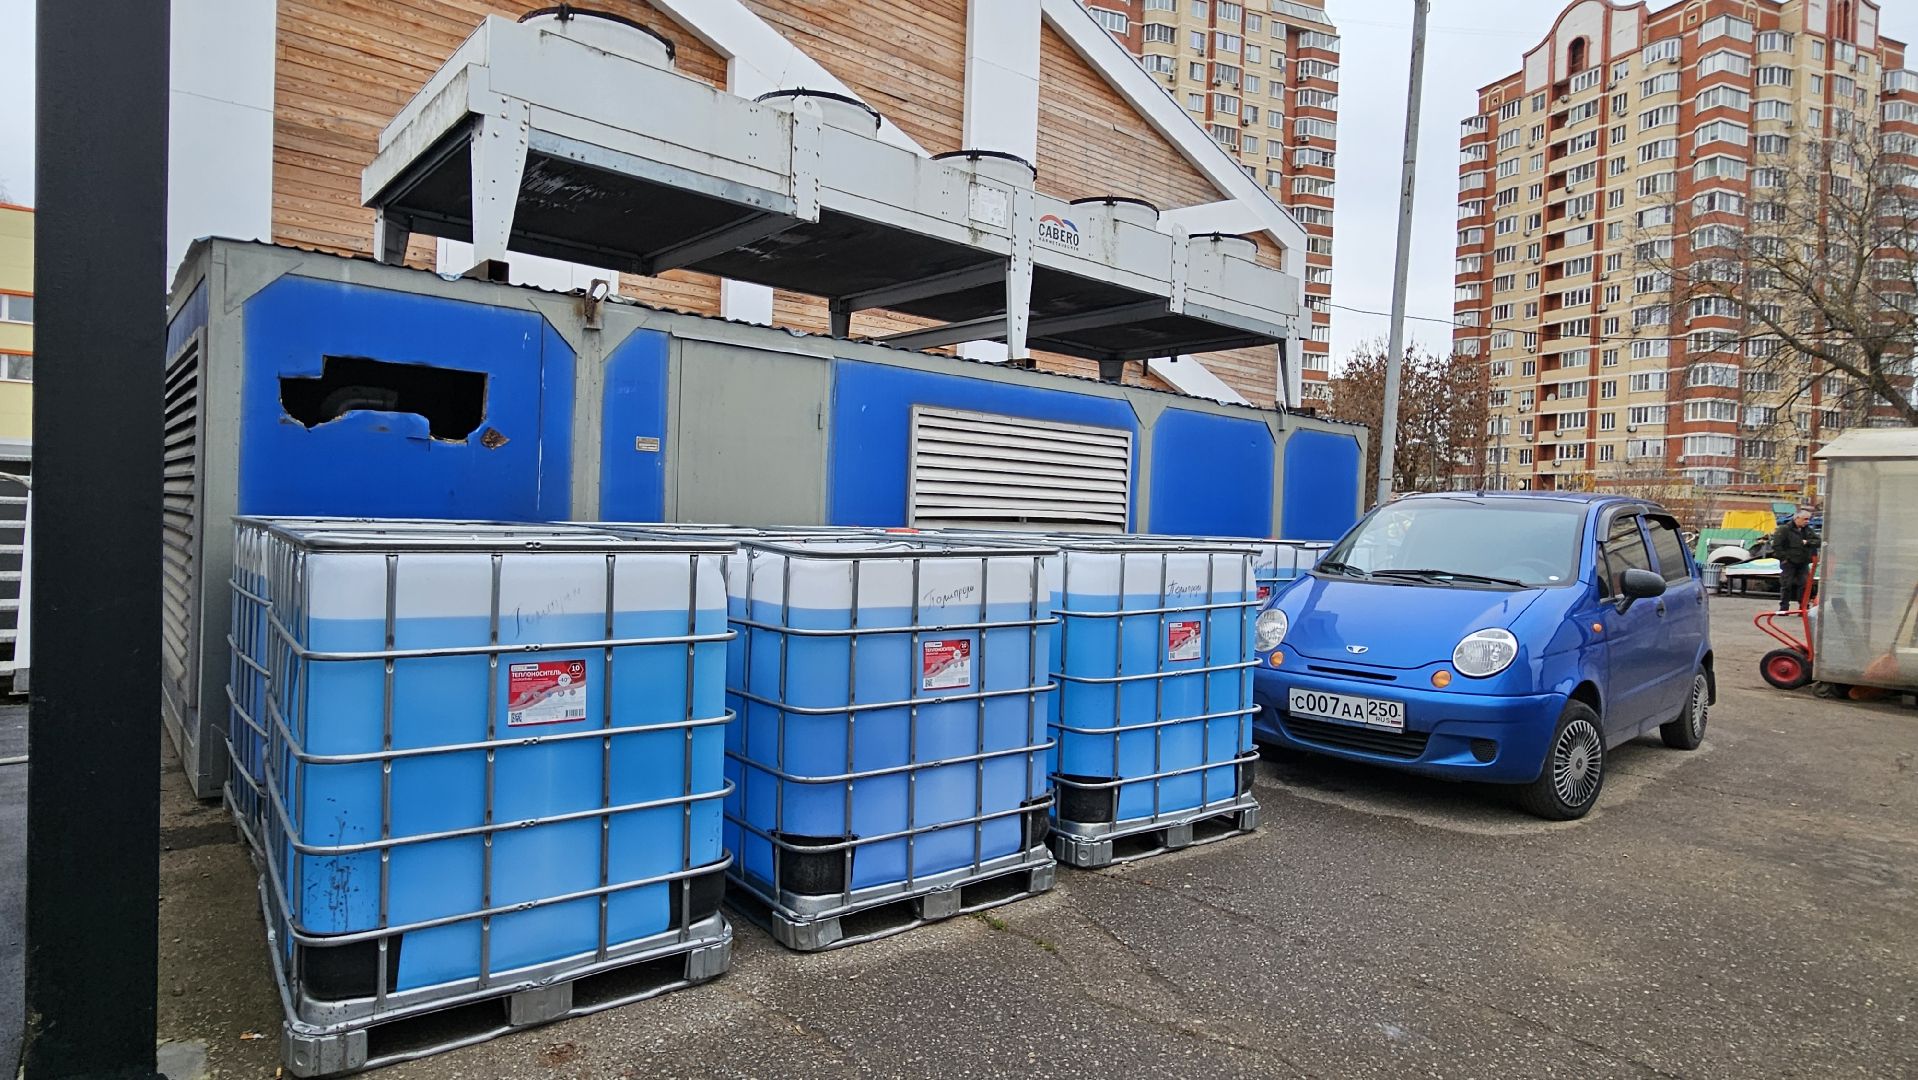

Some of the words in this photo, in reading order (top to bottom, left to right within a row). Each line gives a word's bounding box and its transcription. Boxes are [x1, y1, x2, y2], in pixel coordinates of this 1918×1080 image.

[1039, 223, 1079, 246] CABERO
[511, 670, 562, 678] ТЕПЛОНОСИТЕЛЬ
[1295, 693, 1364, 719] С007АА
[1368, 701, 1398, 718] 250
